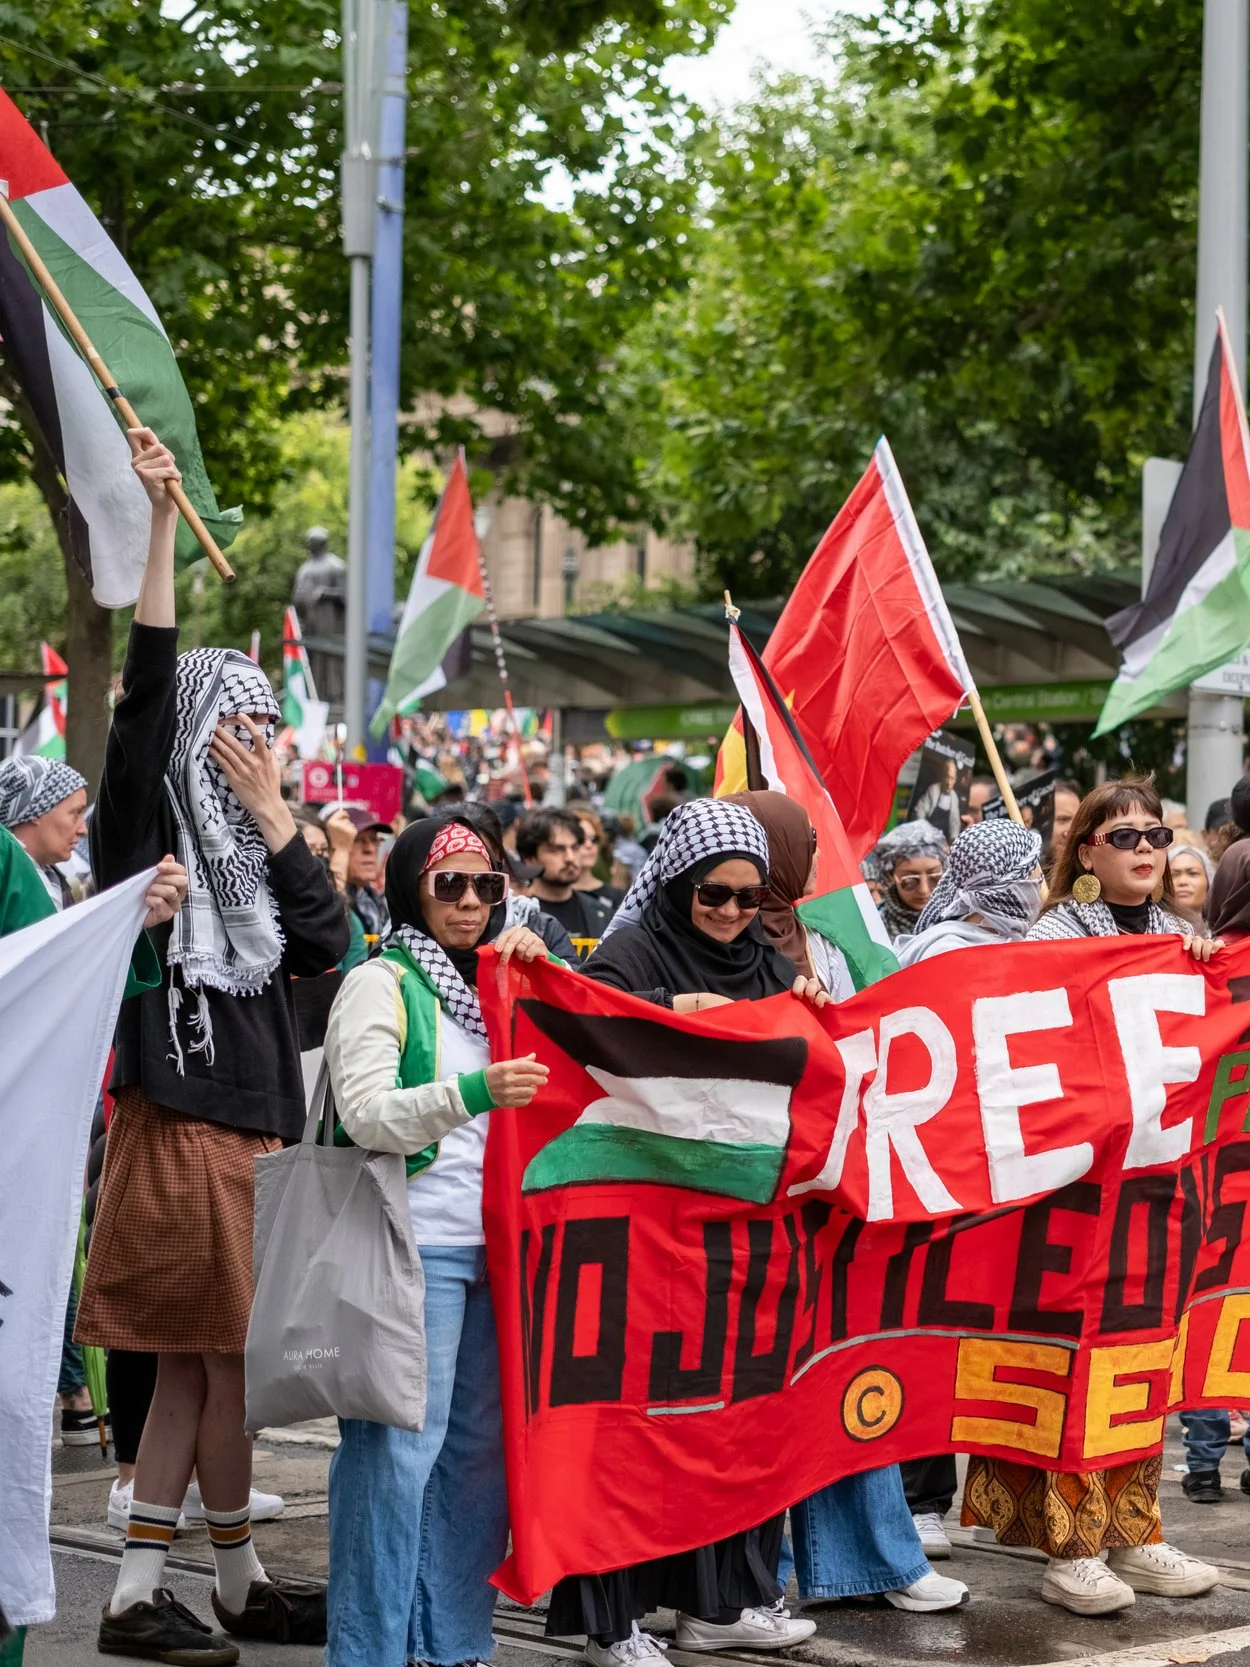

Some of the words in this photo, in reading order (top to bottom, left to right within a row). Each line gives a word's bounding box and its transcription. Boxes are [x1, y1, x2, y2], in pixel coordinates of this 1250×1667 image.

[283, 1350, 303, 1361] AURA
[305, 1346, 340, 1360] HOME
[521, 1215, 630, 1425] NO
